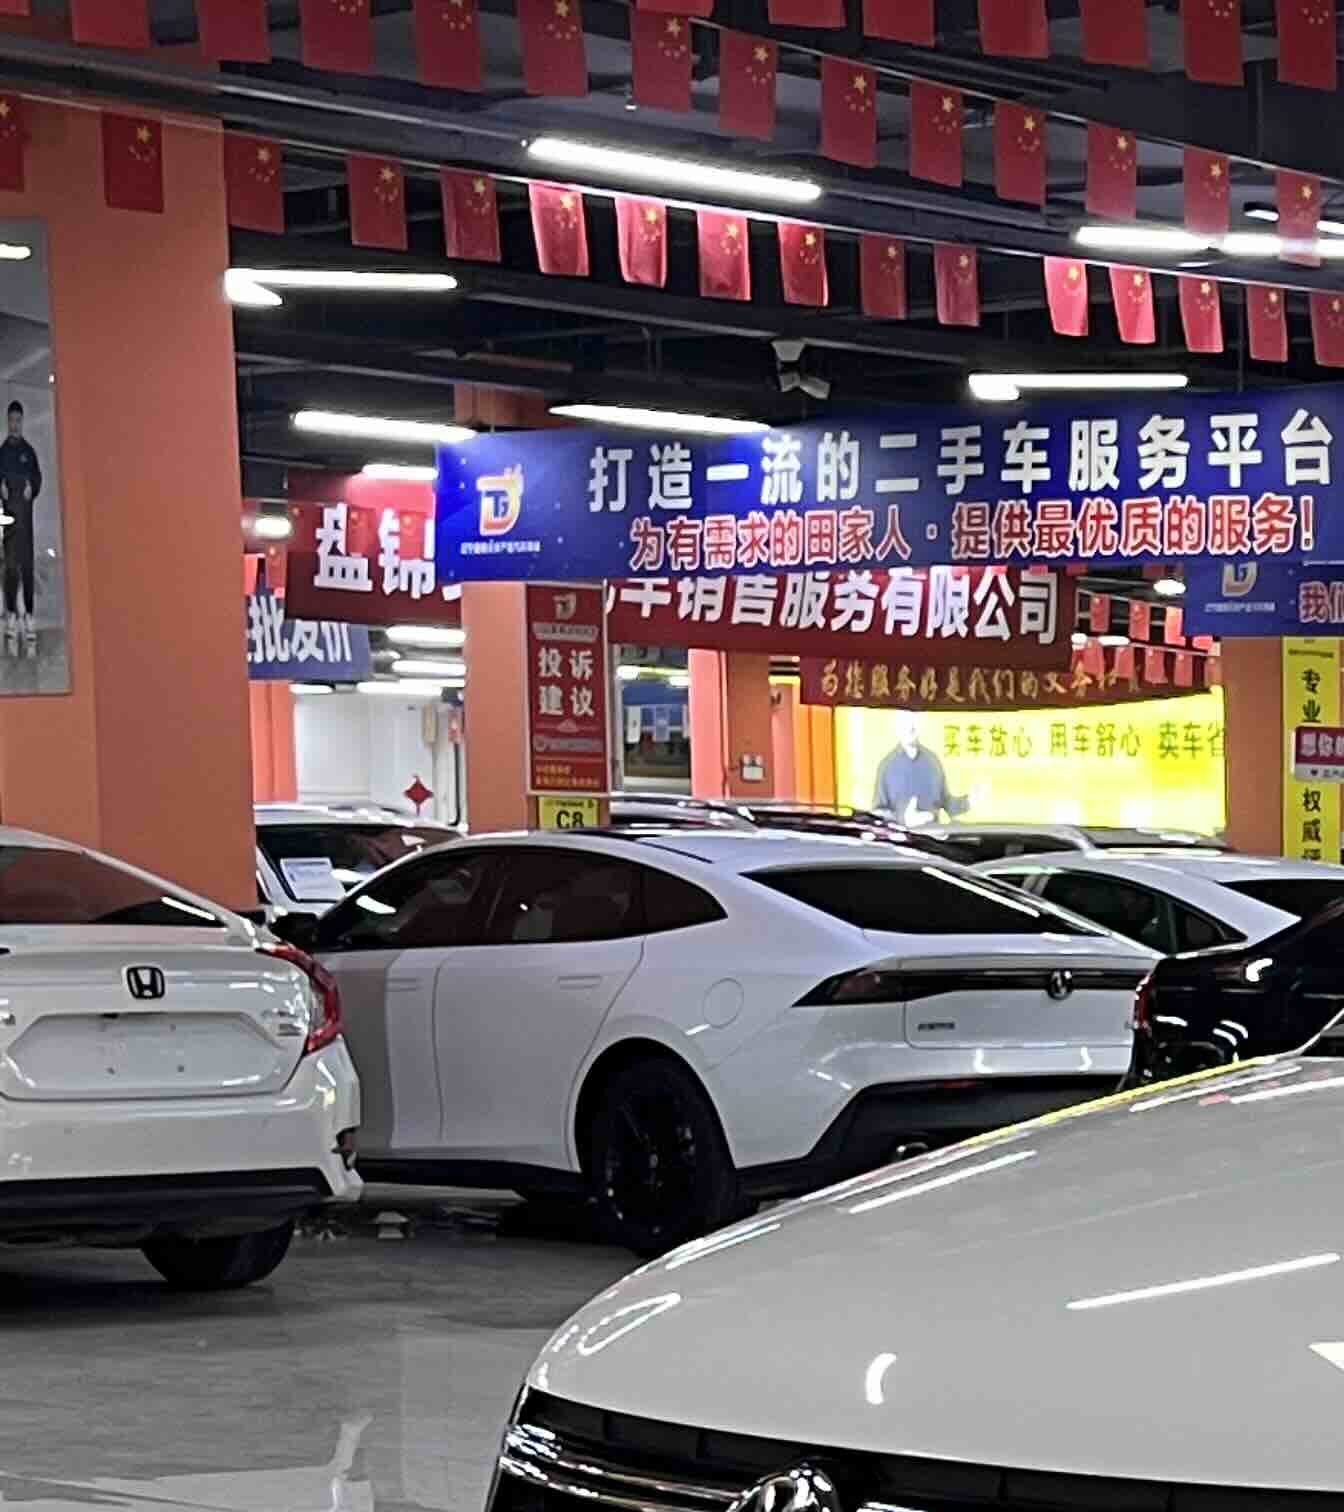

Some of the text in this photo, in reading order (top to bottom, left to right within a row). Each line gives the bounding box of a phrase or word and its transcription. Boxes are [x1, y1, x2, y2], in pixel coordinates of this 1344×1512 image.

[588, 407, 1335, 513] 打造一流的二手车服务平台
[313, 502, 463, 602] 盘锦
[246, 594, 353, 664] 批发价
[604, 564, 1060, 646] 车销售服务有限公司
[538, 647, 593, 681] 投诉
[538, 683, 594, 717] 建议
[943, 724, 1033, 758] 买车放心
[1049, 722, 1142, 759] 用车舒心
